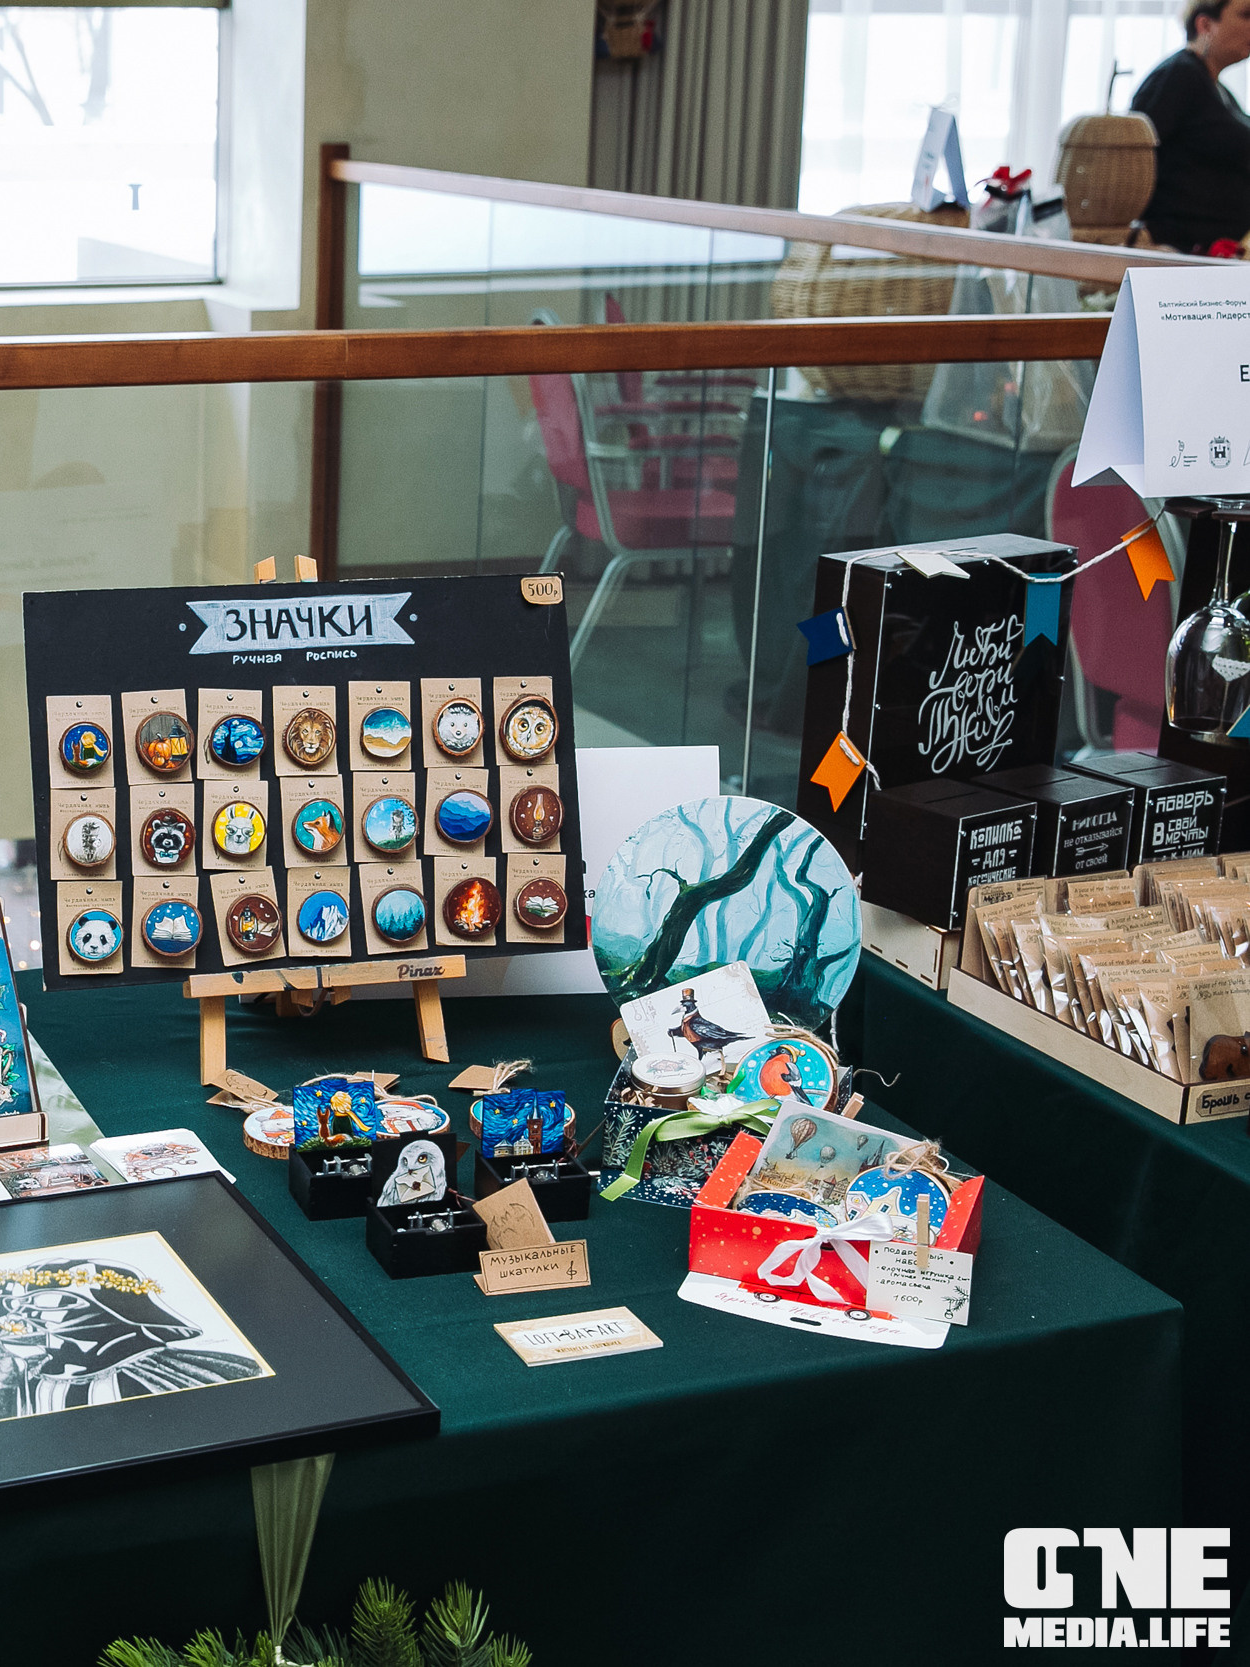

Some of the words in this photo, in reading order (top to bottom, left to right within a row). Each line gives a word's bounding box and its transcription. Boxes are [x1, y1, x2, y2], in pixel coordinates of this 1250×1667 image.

[1158, 300, 1198, 308] Балтийский
[226, 604, 373, 641] ЗНАЧКИ
[1064, 838, 1074, 848] не
[1075, 826, 1124, 846] отказывайся
[1152, 822, 1164, 846] В
[1076, 860, 1084, 870] от
[1086, 853, 1108, 868] своей
[1202, 1094, 1239, 1114] Брошь
